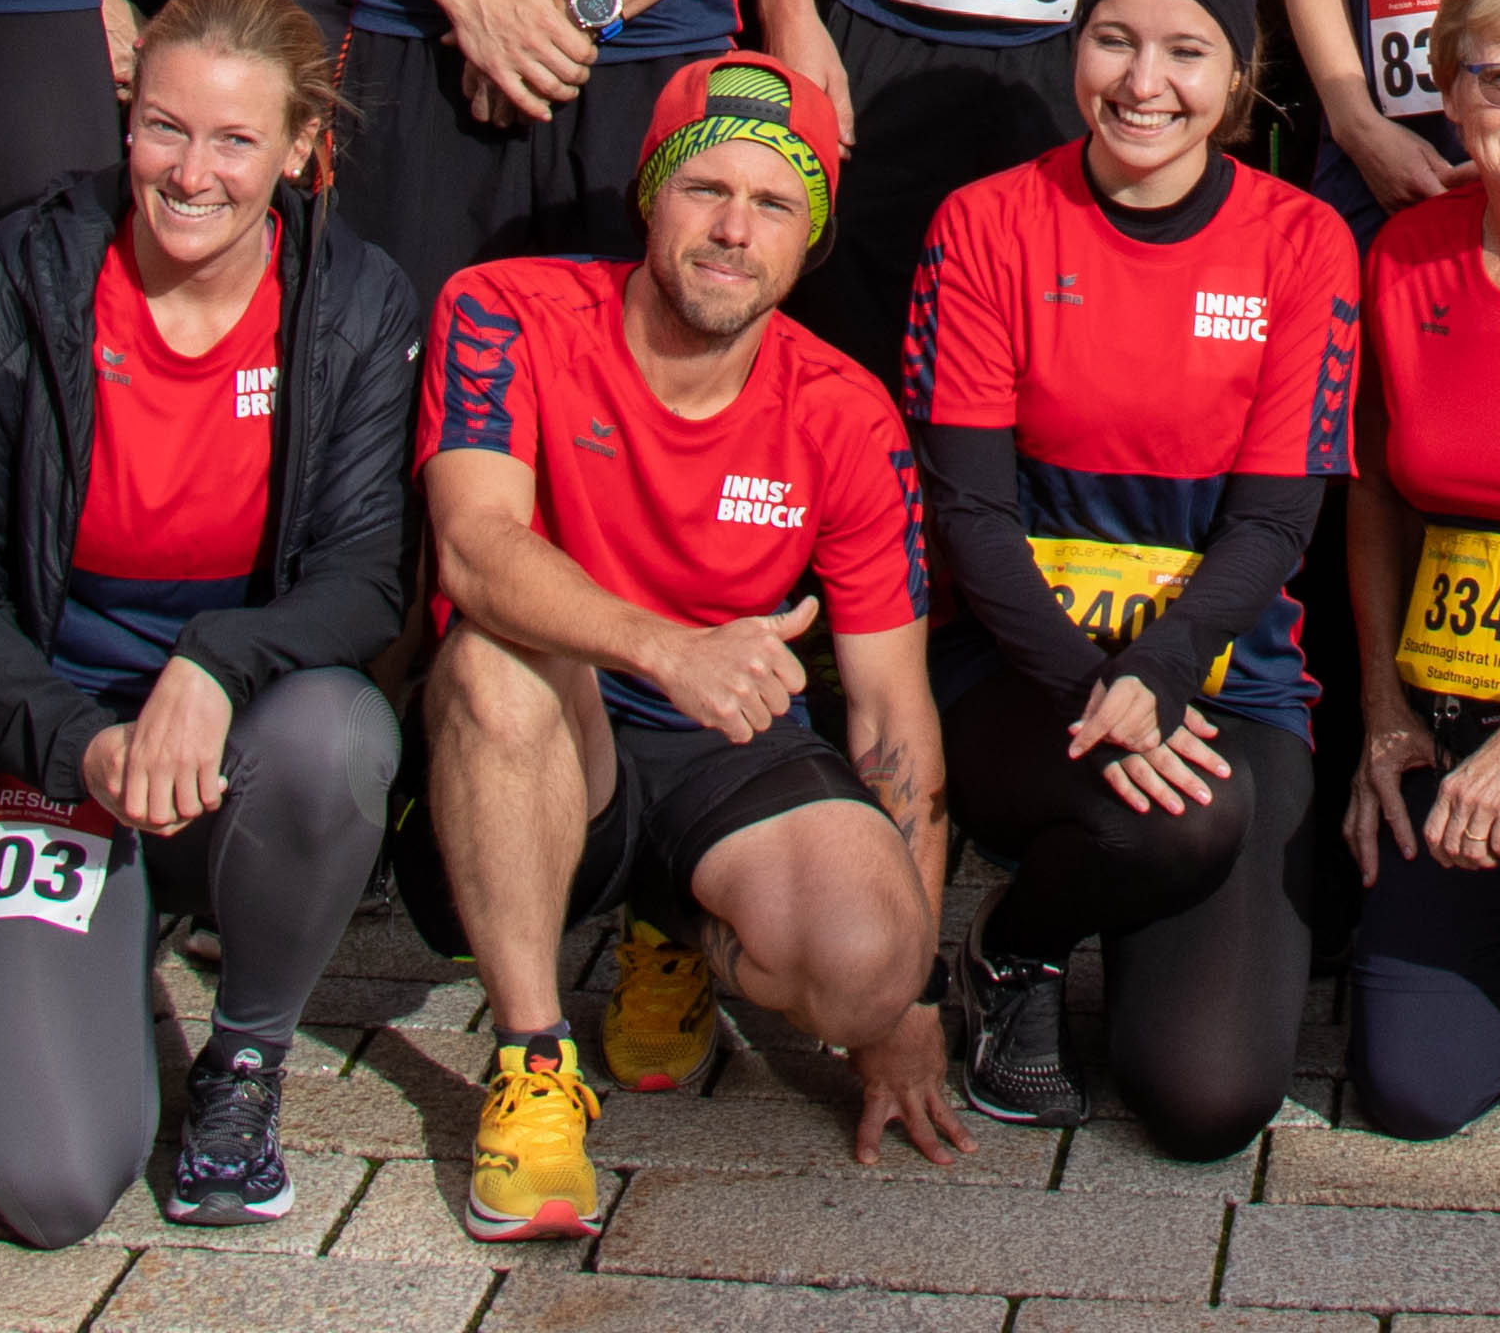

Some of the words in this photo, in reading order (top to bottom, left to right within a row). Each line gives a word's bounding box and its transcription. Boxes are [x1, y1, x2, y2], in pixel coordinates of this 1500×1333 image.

[1196, 291, 1268, 319] INNS'
[722, 474, 793, 504] INNS'
[717, 497, 807, 529] BRUCK
[1403, 637, 1490, 667] Stadtmagistrat
